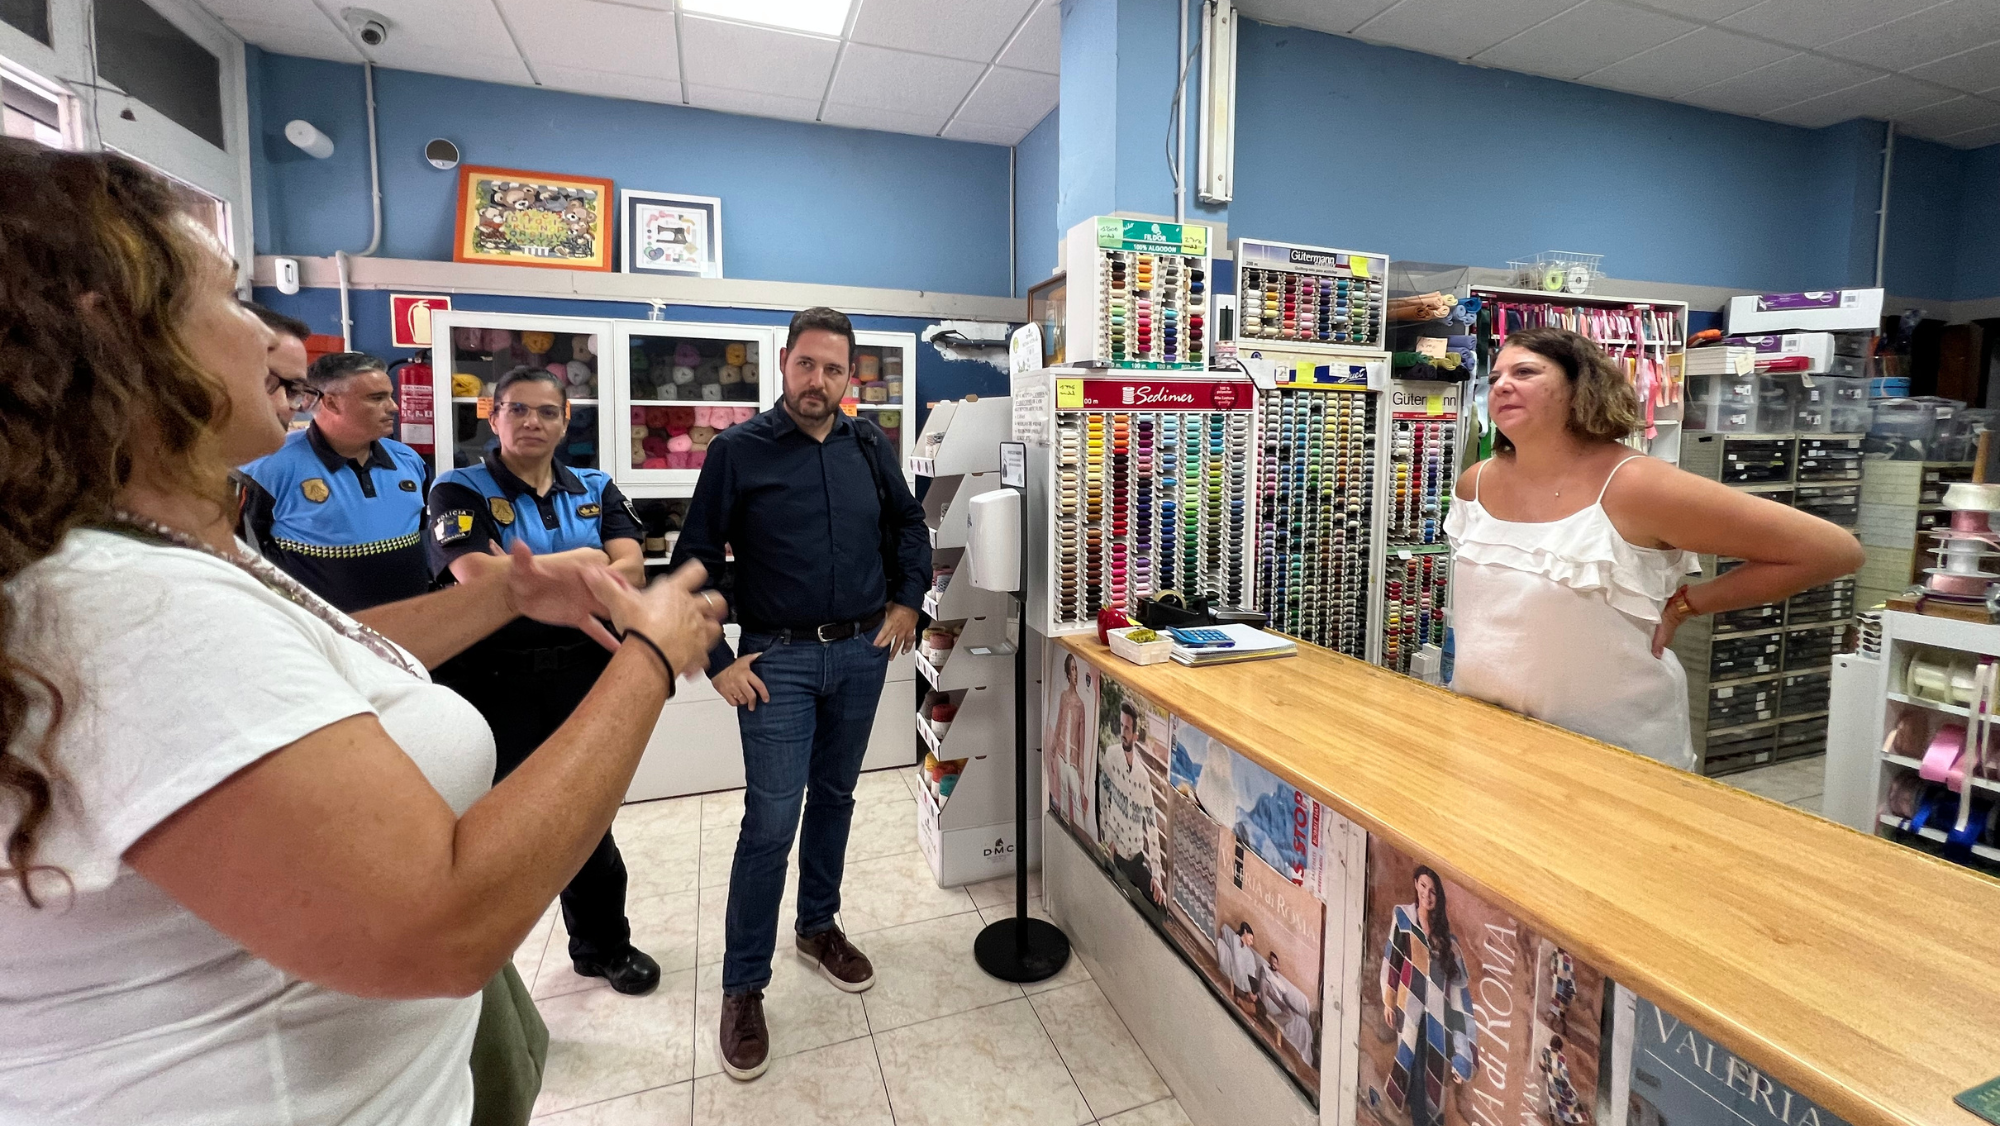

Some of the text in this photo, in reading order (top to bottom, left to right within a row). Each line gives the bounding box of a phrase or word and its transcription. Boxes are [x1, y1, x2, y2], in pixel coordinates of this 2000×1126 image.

[1144, 233, 1167, 242] FILDOR
[1133, 243, 1148, 251] 100%
[1290, 250, 1335, 264] Gütermann
[1134, 386, 1195, 405] Sedimer
[1392, 391, 1457, 406] Güternn
[436, 510, 467, 524] POLICIA
[1293, 790, 1308, 857] STOP
[1265, 892, 1274, 908] di
[1477, 1046, 1508, 1091] di
[1654, 1004, 1821, 1126] VALERIA
